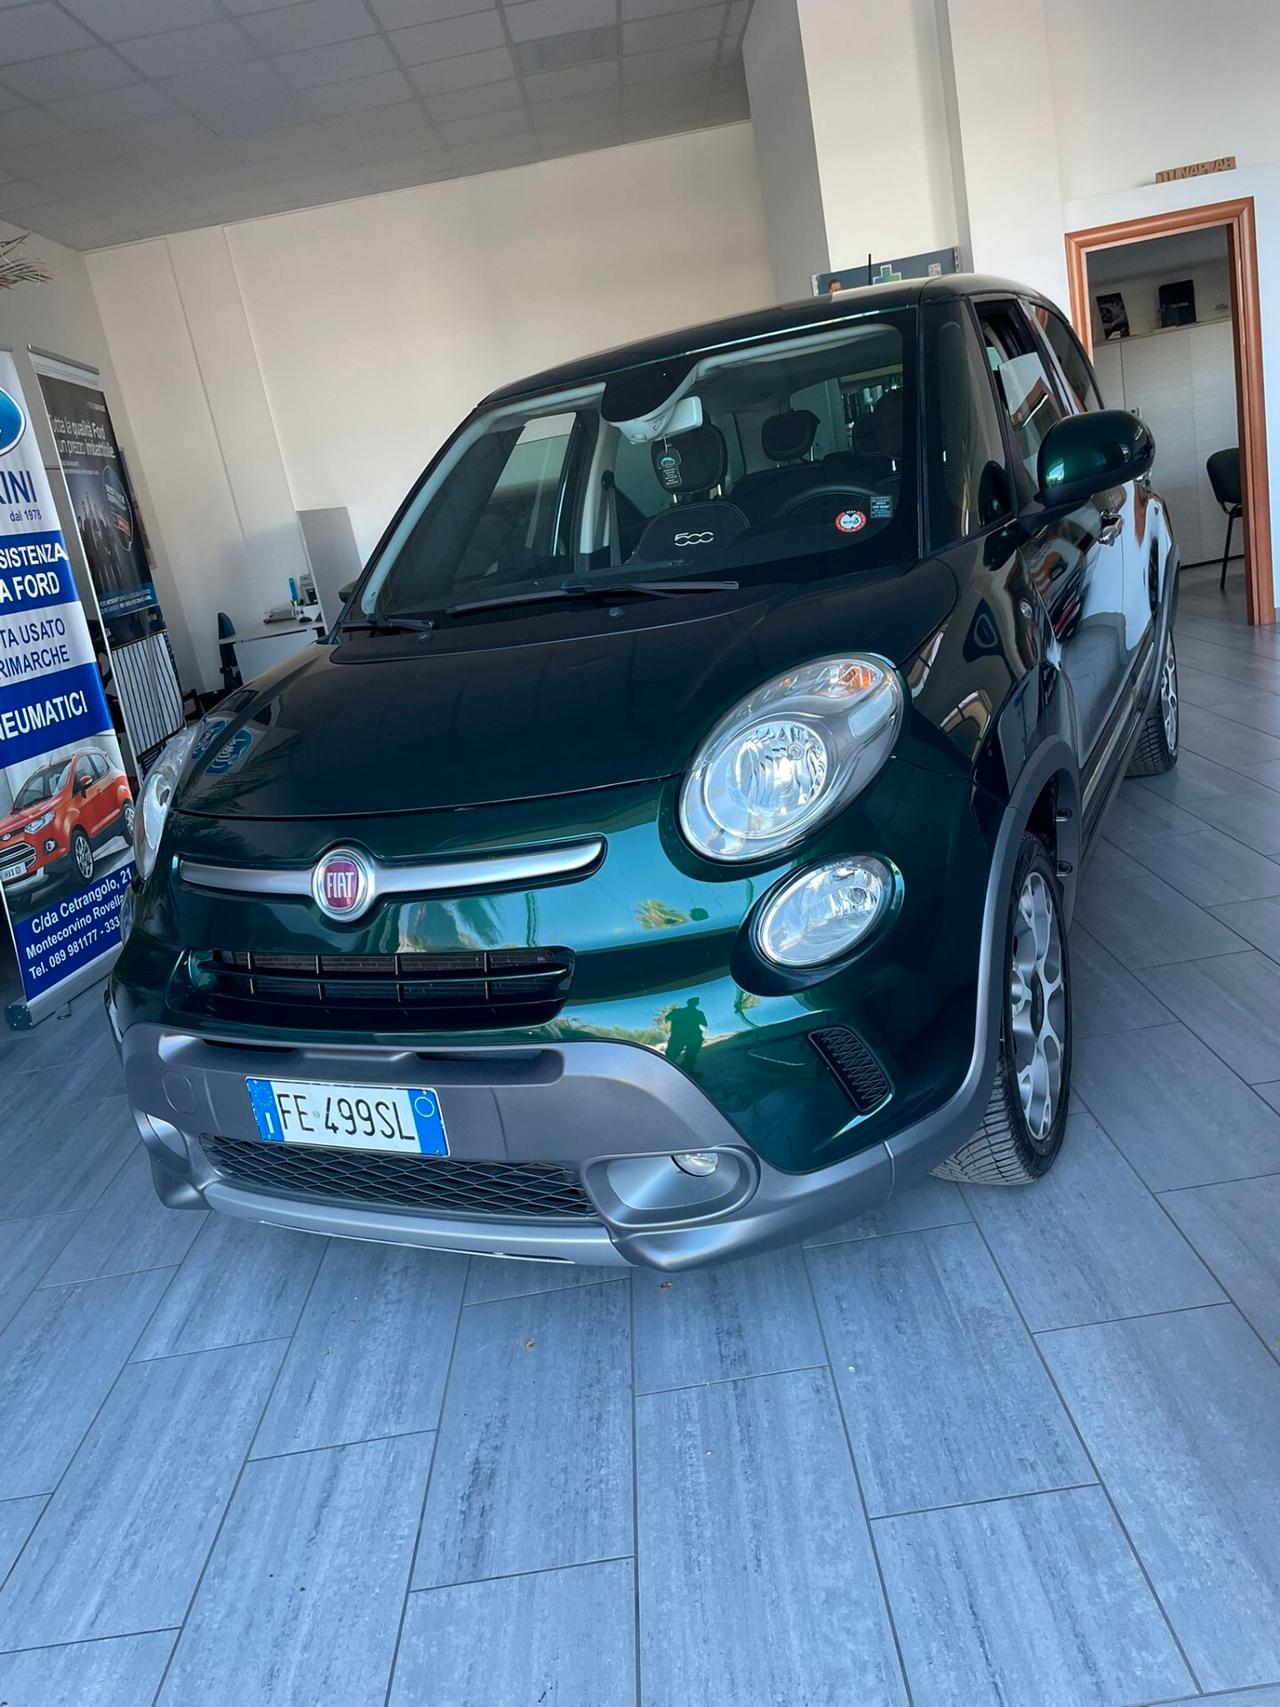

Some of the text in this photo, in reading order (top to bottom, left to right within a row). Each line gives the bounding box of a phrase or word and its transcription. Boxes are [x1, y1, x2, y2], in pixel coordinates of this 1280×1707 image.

[0, 470, 37, 504] INI
[9, 509, 42, 522] dal 1978
[674, 531, 714, 547] 500
[12, 571, 60, 600] FORD
[19, 617, 65, 644] USATO
[326, 871, 355, 898] FIAT
[31, 867, 132, 934] C/da Cetrangolo, 21
[25, 914, 92, 959] Montecorvino
[28, 962, 48, 980] Tel.
[49, 949, 66, 968] 089
[67, 928, 98, 957] 981177
[104, 914, 121, 933] 333
[277, 1093, 314, 1132] FE
[325, 1096, 416, 1140] 499SL
